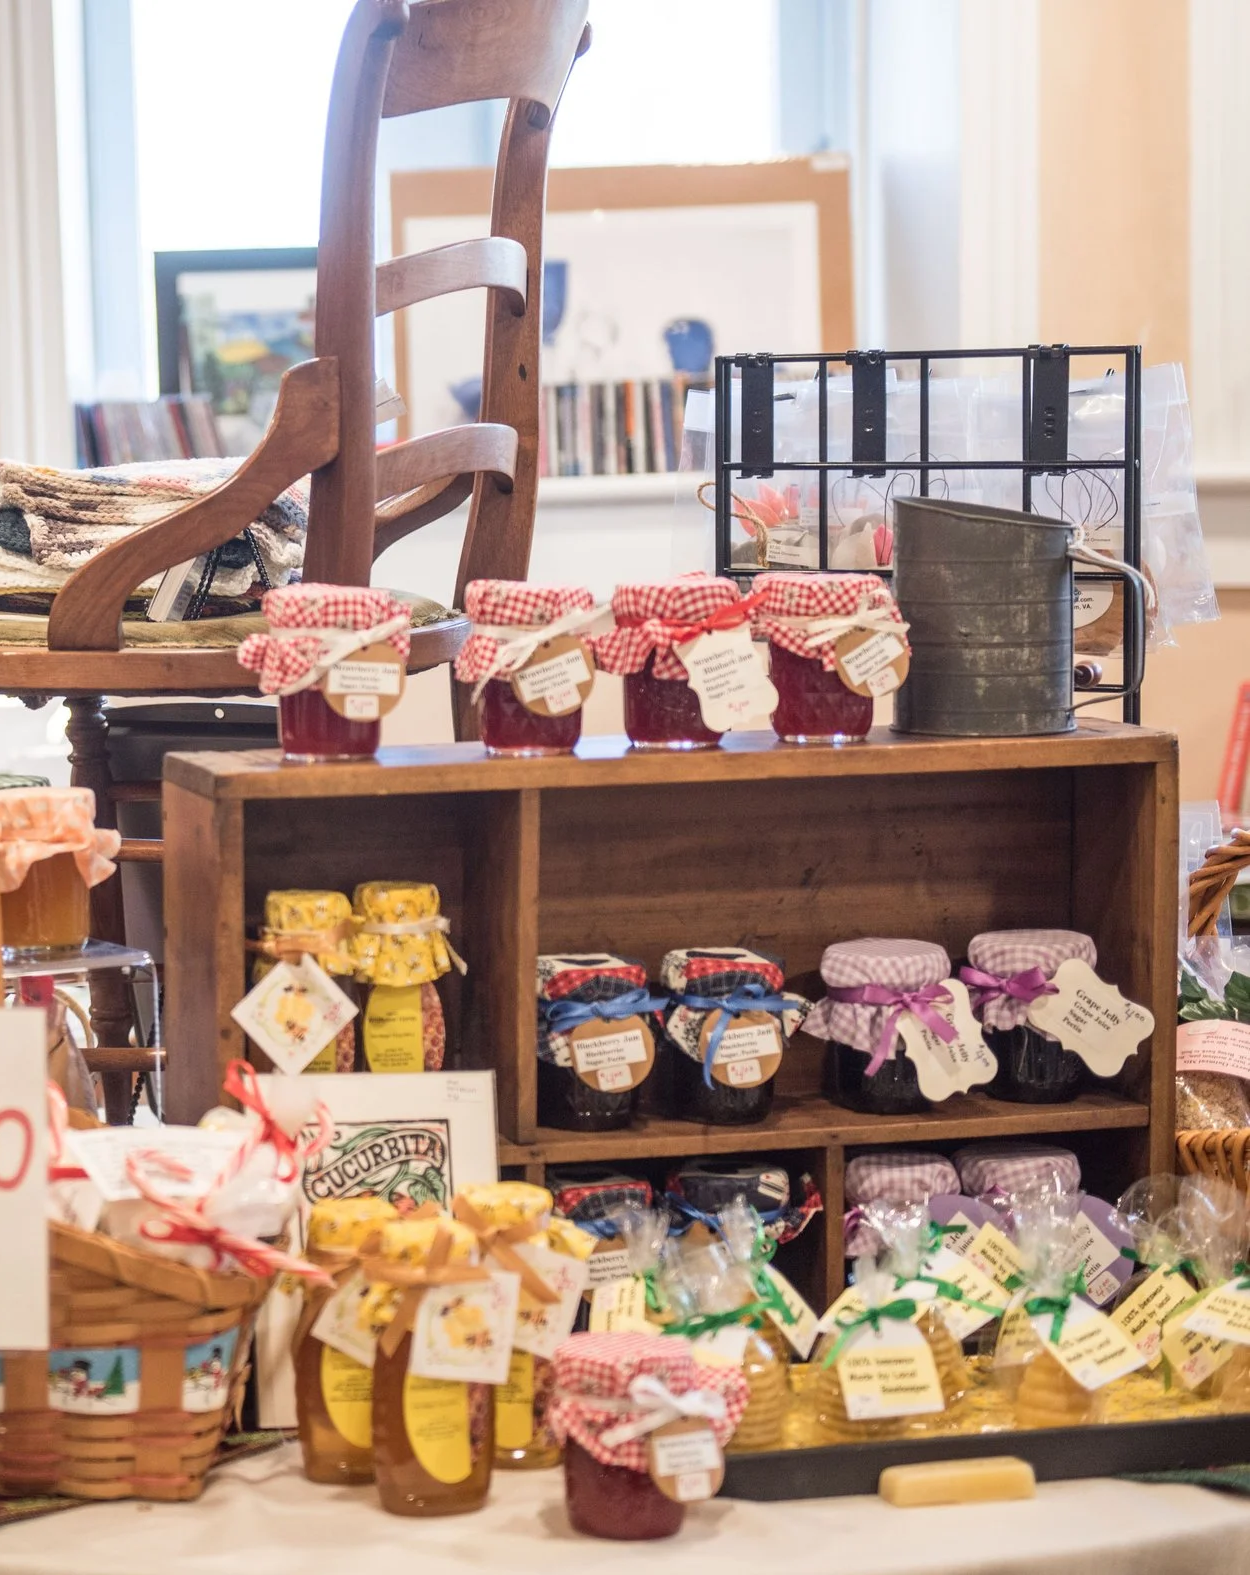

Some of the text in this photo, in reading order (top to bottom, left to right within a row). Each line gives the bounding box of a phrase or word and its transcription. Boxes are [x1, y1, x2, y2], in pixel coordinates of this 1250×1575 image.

[1068, 1008, 1088, 1026] Sugar
[1073, 1000, 1111, 1032] Grape Juice
[1075, 988, 1121, 1027] Grape Jelly
[1062, 1015, 1083, 1034] Pectin
[957, 1043, 970, 1063] Jelly
[310, 1133, 438, 1199] CUCURBITA
[1083, 1262, 1102, 1279] ectin
[1120, 1283, 1165, 1328] 100% beeswax
[1129, 1317, 1148, 1337] Made
[1147, 1308, 1158, 1320] by
[847, 1356, 871, 1368] 100%
[848, 1371, 874, 1382] Made
